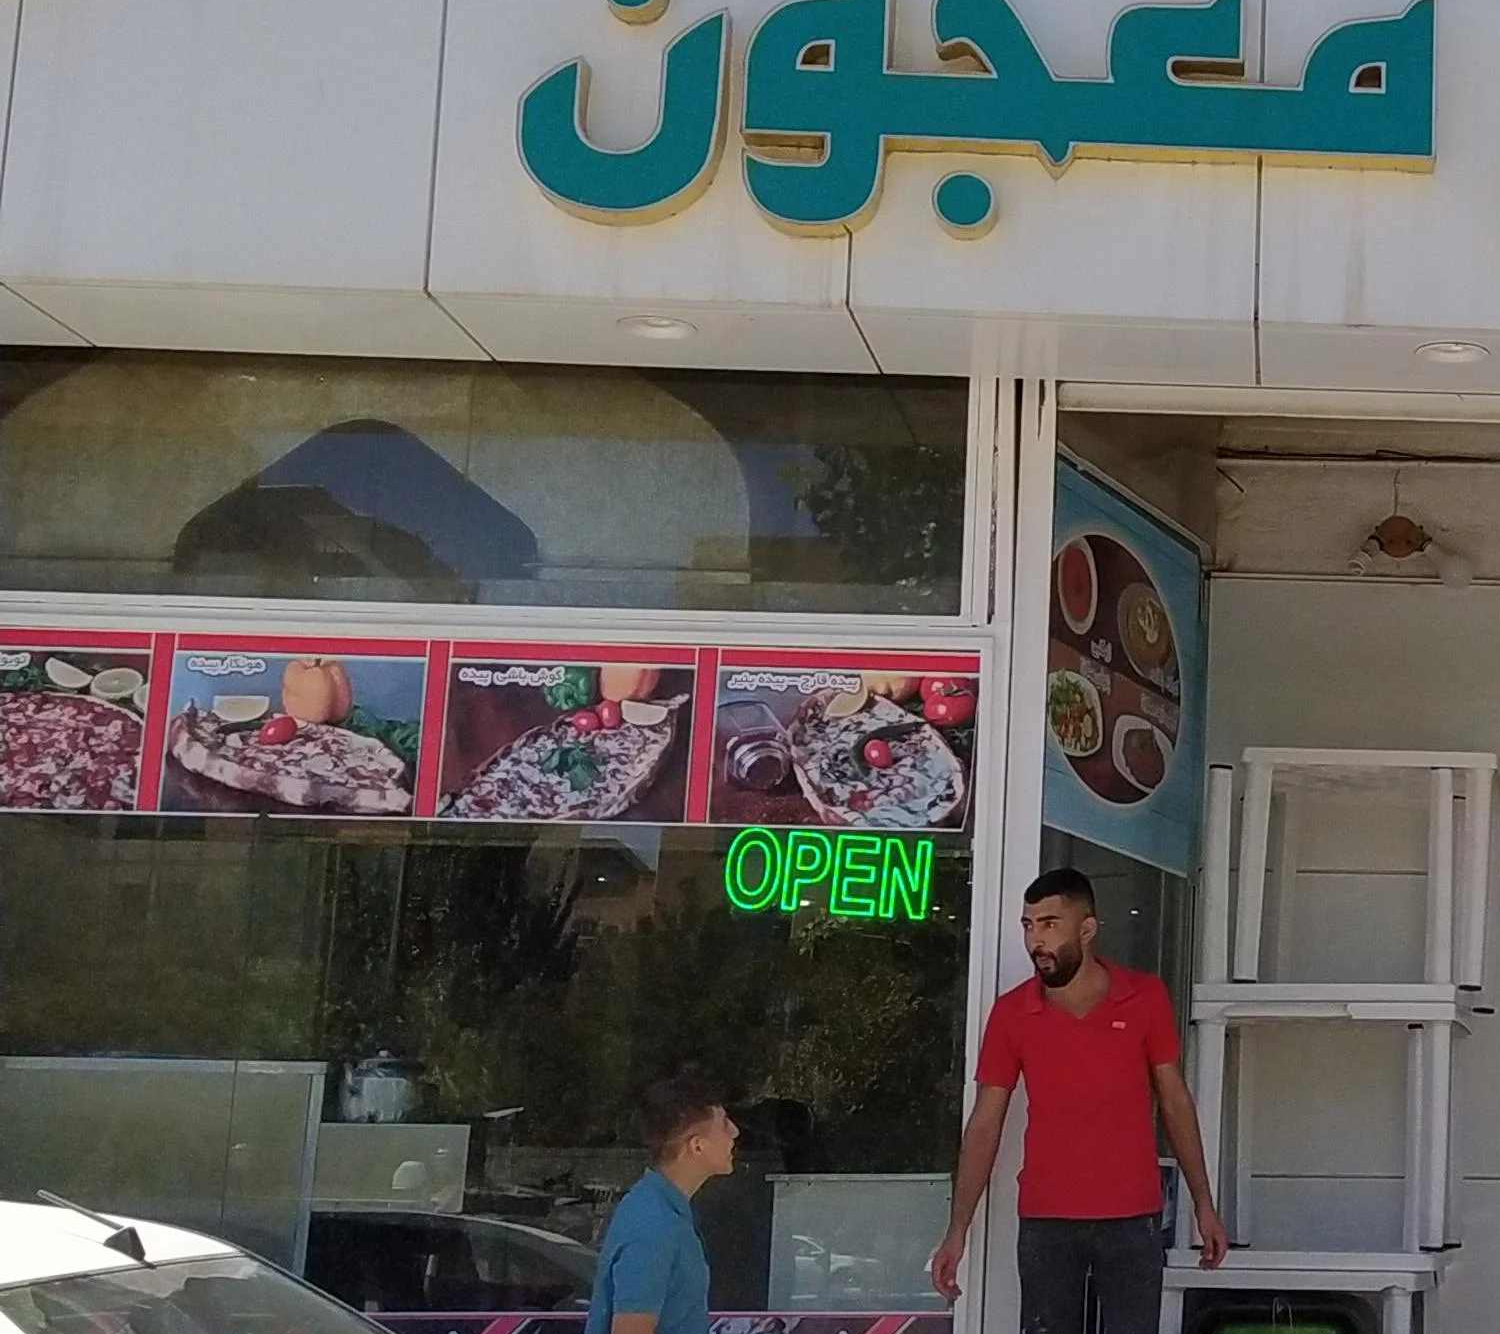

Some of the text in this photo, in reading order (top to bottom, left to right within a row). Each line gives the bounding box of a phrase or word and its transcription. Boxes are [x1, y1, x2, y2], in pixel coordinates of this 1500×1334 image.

[459, 668, 492, 686] پیده
[757, 673, 788, 691] پیده
[829, 675, 861, 693] پیده
[725, 827, 933, 921] OPEN
